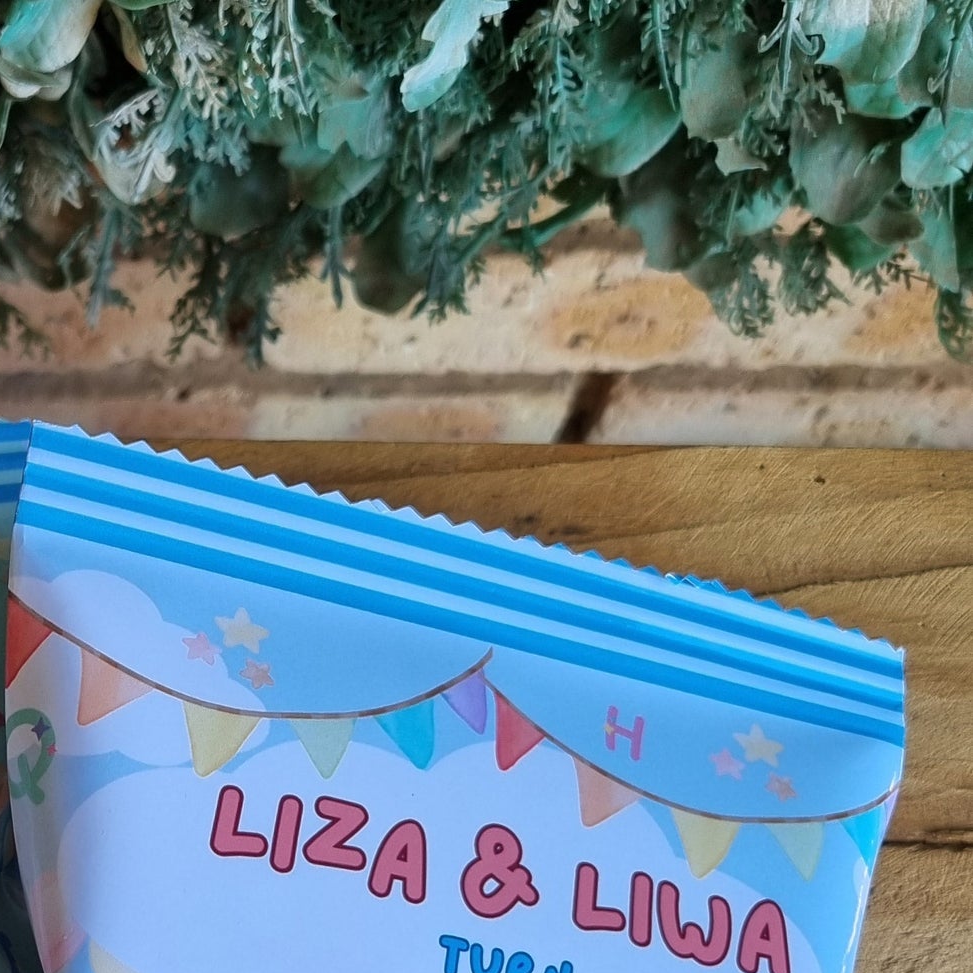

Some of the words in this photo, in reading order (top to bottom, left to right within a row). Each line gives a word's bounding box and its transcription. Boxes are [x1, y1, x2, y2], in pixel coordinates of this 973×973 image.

[605, 705, 645, 761] H
[210, 784, 427, 904] LIZA
[461, 823, 540, 919] &
